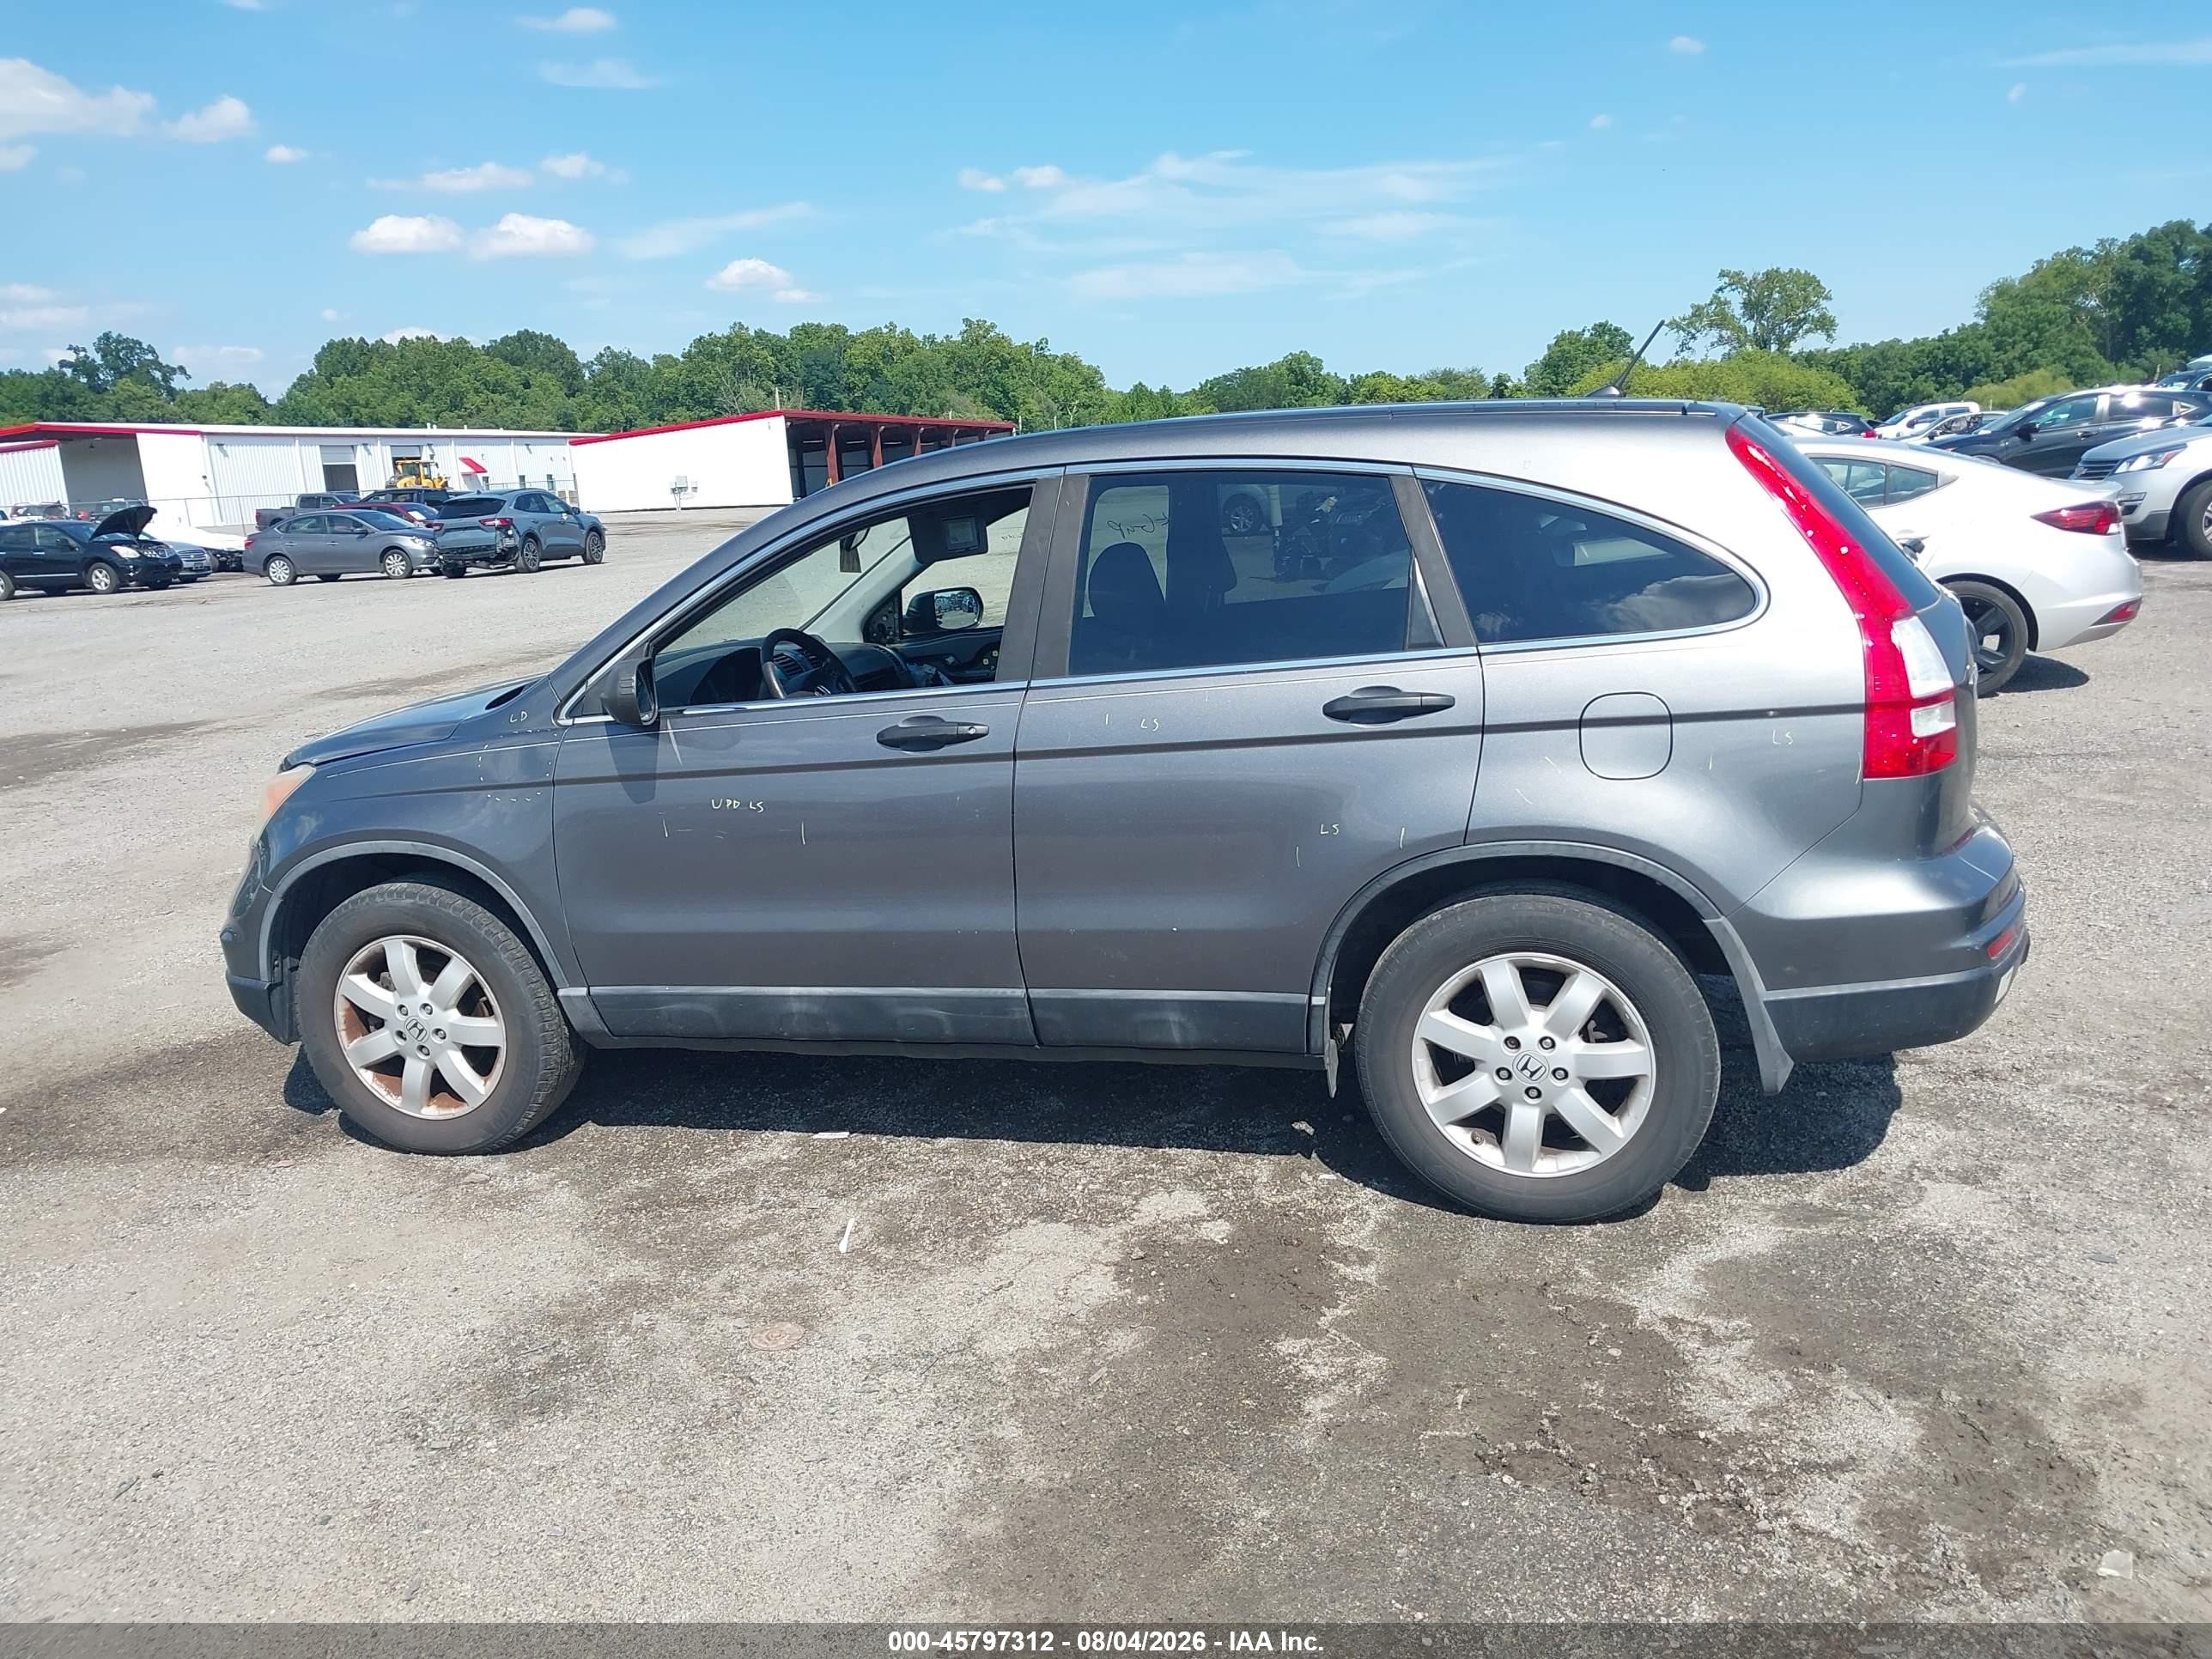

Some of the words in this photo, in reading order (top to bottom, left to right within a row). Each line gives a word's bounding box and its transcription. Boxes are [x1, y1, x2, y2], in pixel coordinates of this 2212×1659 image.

[509, 710, 528, 723] LD
[1140, 718, 1159, 732] LS
[1772, 729, 1794, 745] LS
[711, 799, 741, 810] UPD
[749, 800, 764, 813] LS
[1320, 823, 1340, 836] LS
